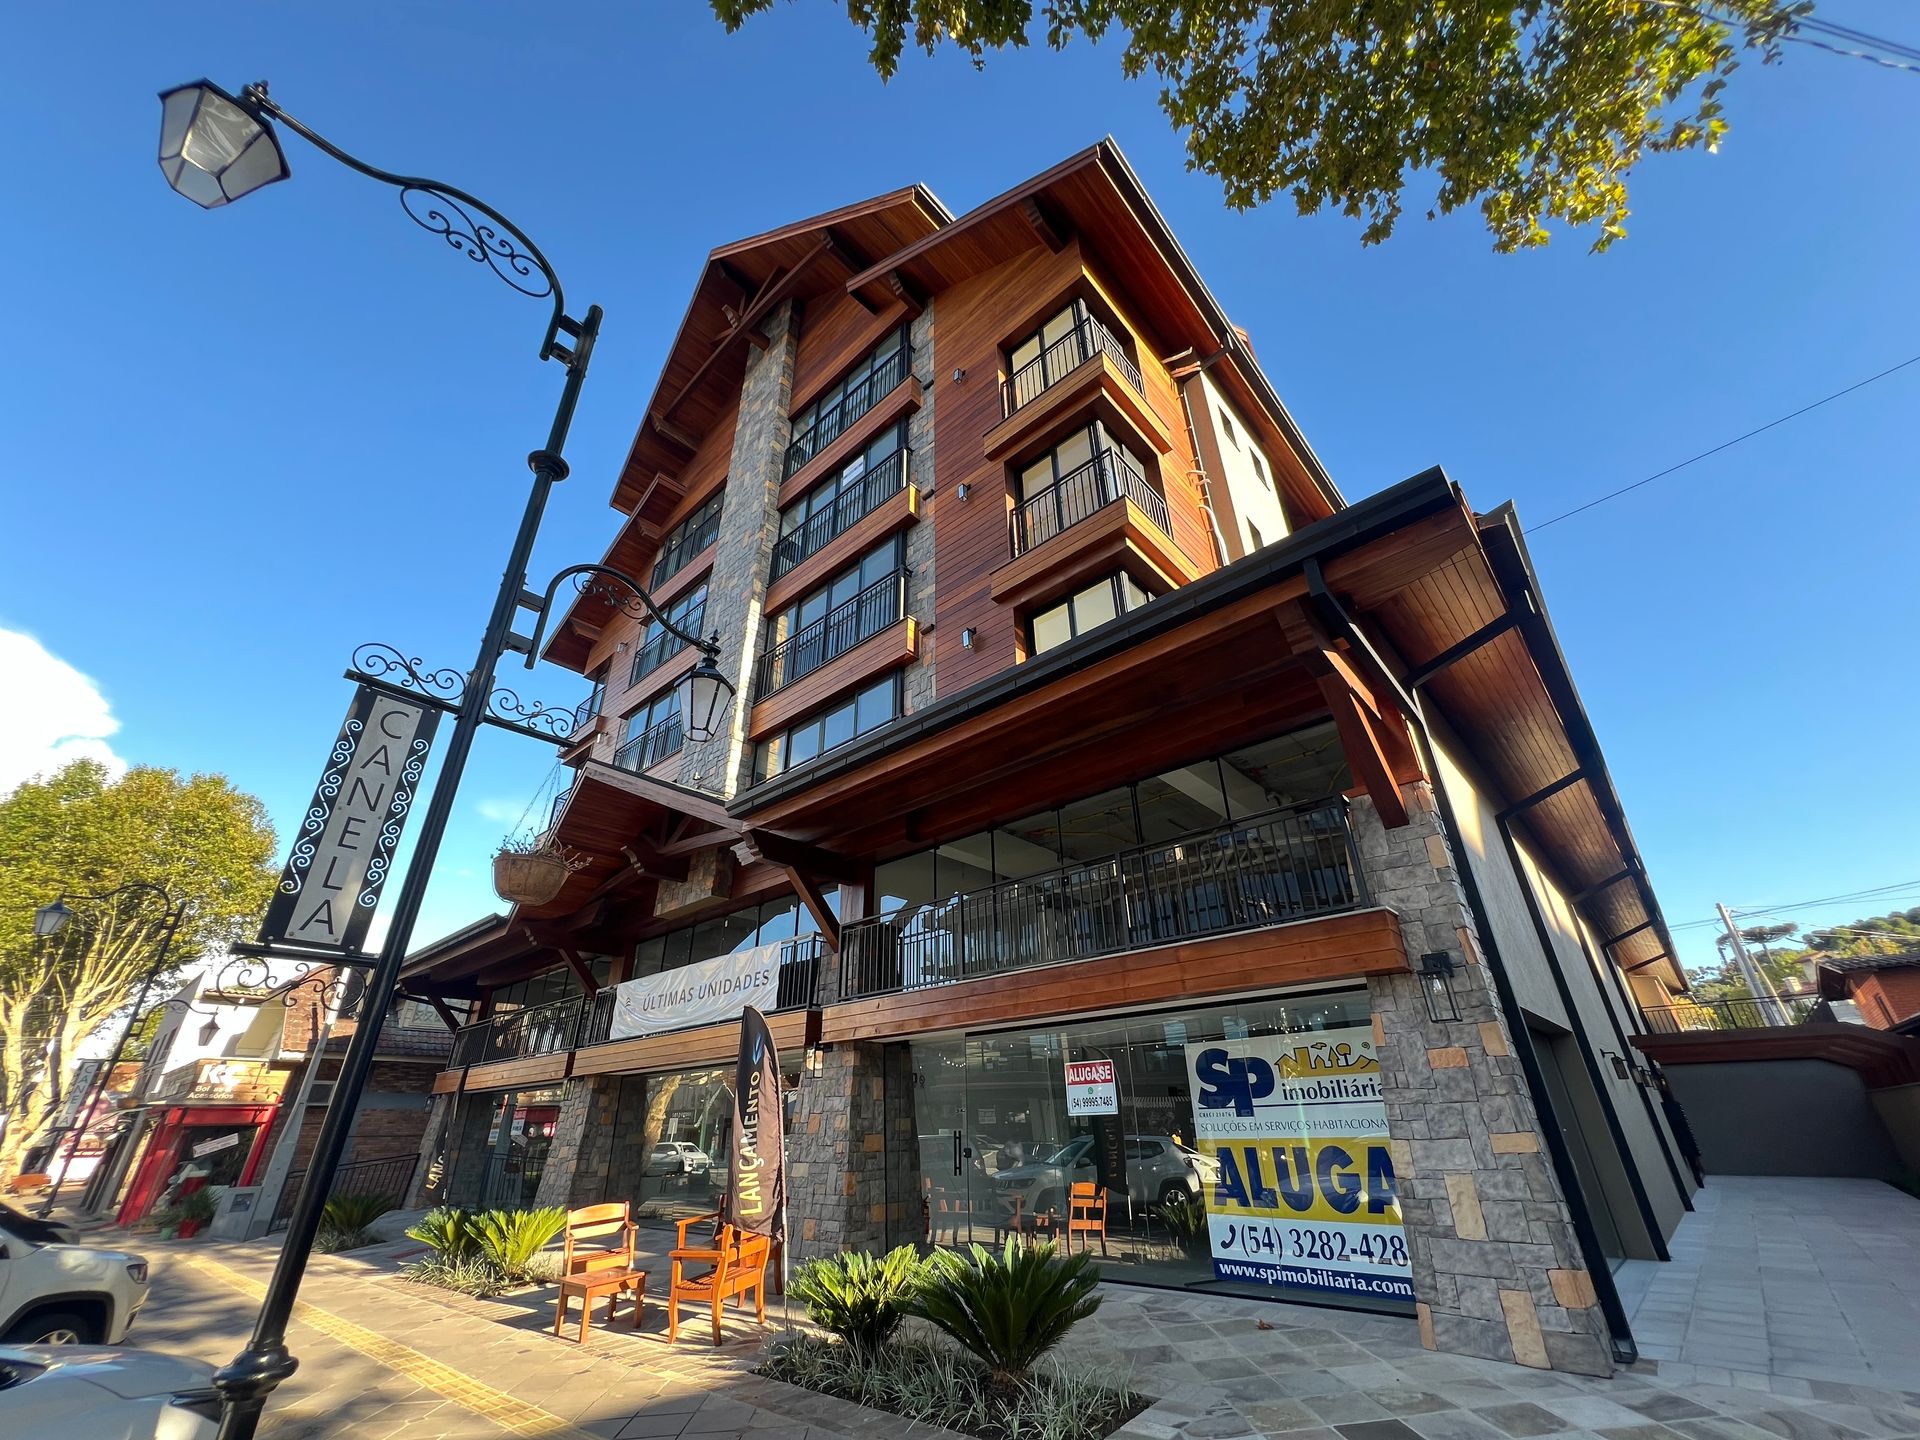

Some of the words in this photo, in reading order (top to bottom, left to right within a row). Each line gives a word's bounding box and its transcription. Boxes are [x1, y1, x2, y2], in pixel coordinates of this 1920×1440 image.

[298, 709, 410, 936] CANELA
[642, 987, 695, 1012] ÚLTIMAS
[698, 969, 770, 1001] UNIDADES
[58, 1064, 95, 1125] CANELA
[738, 1071, 764, 1217] LANÇAMENTO
[1200, 1120, 1247, 1134] SOLUÇÕES
[1249, 1121, 1263, 1131] EM
[1264, 1119, 1311, 1133] SERVIÇOS
[1214, 1145, 1397, 1215] ALUGA
[1240, 1224, 1283, 1260] (54)
[1289, 1227, 1409, 1267] 3282-428
